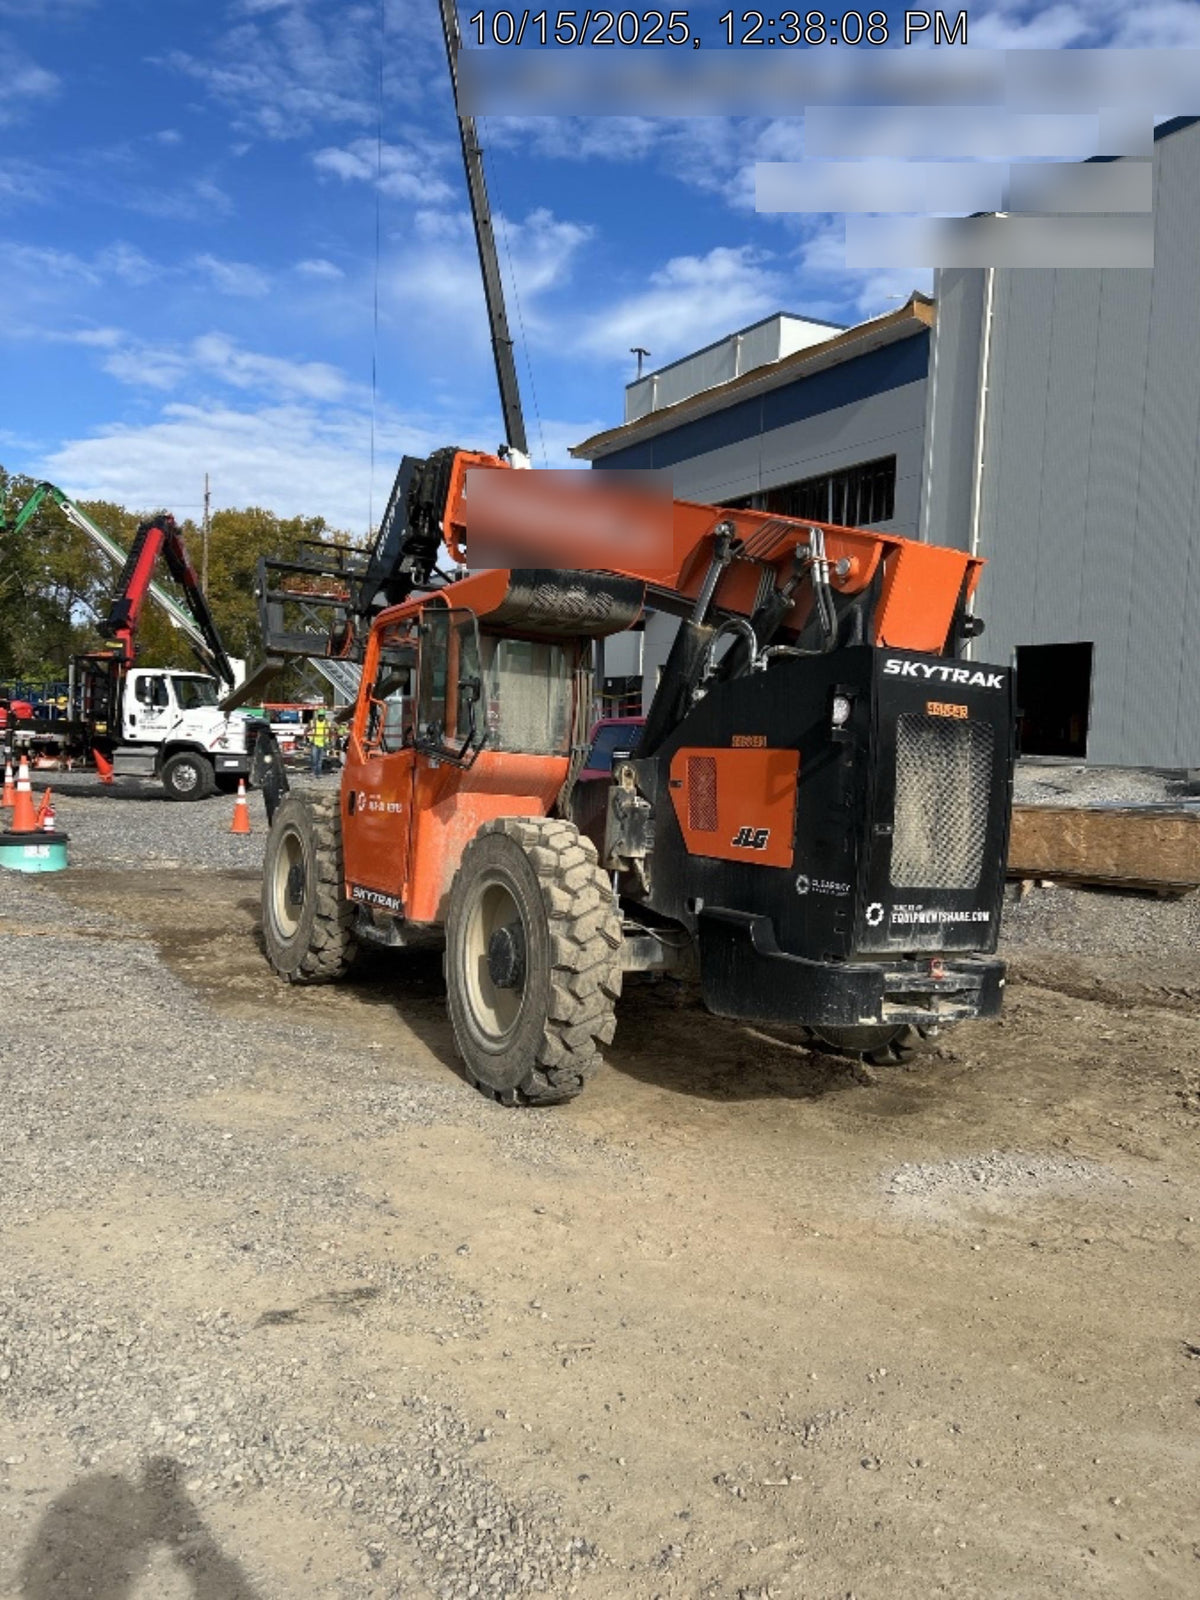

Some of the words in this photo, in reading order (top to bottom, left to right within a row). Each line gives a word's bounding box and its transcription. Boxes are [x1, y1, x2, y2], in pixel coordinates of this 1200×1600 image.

[884, 659, 1004, 688] SKYTRAK
[731, 827, 770, 850] JLG
[353, 887, 400, 910] SKYTRAK
